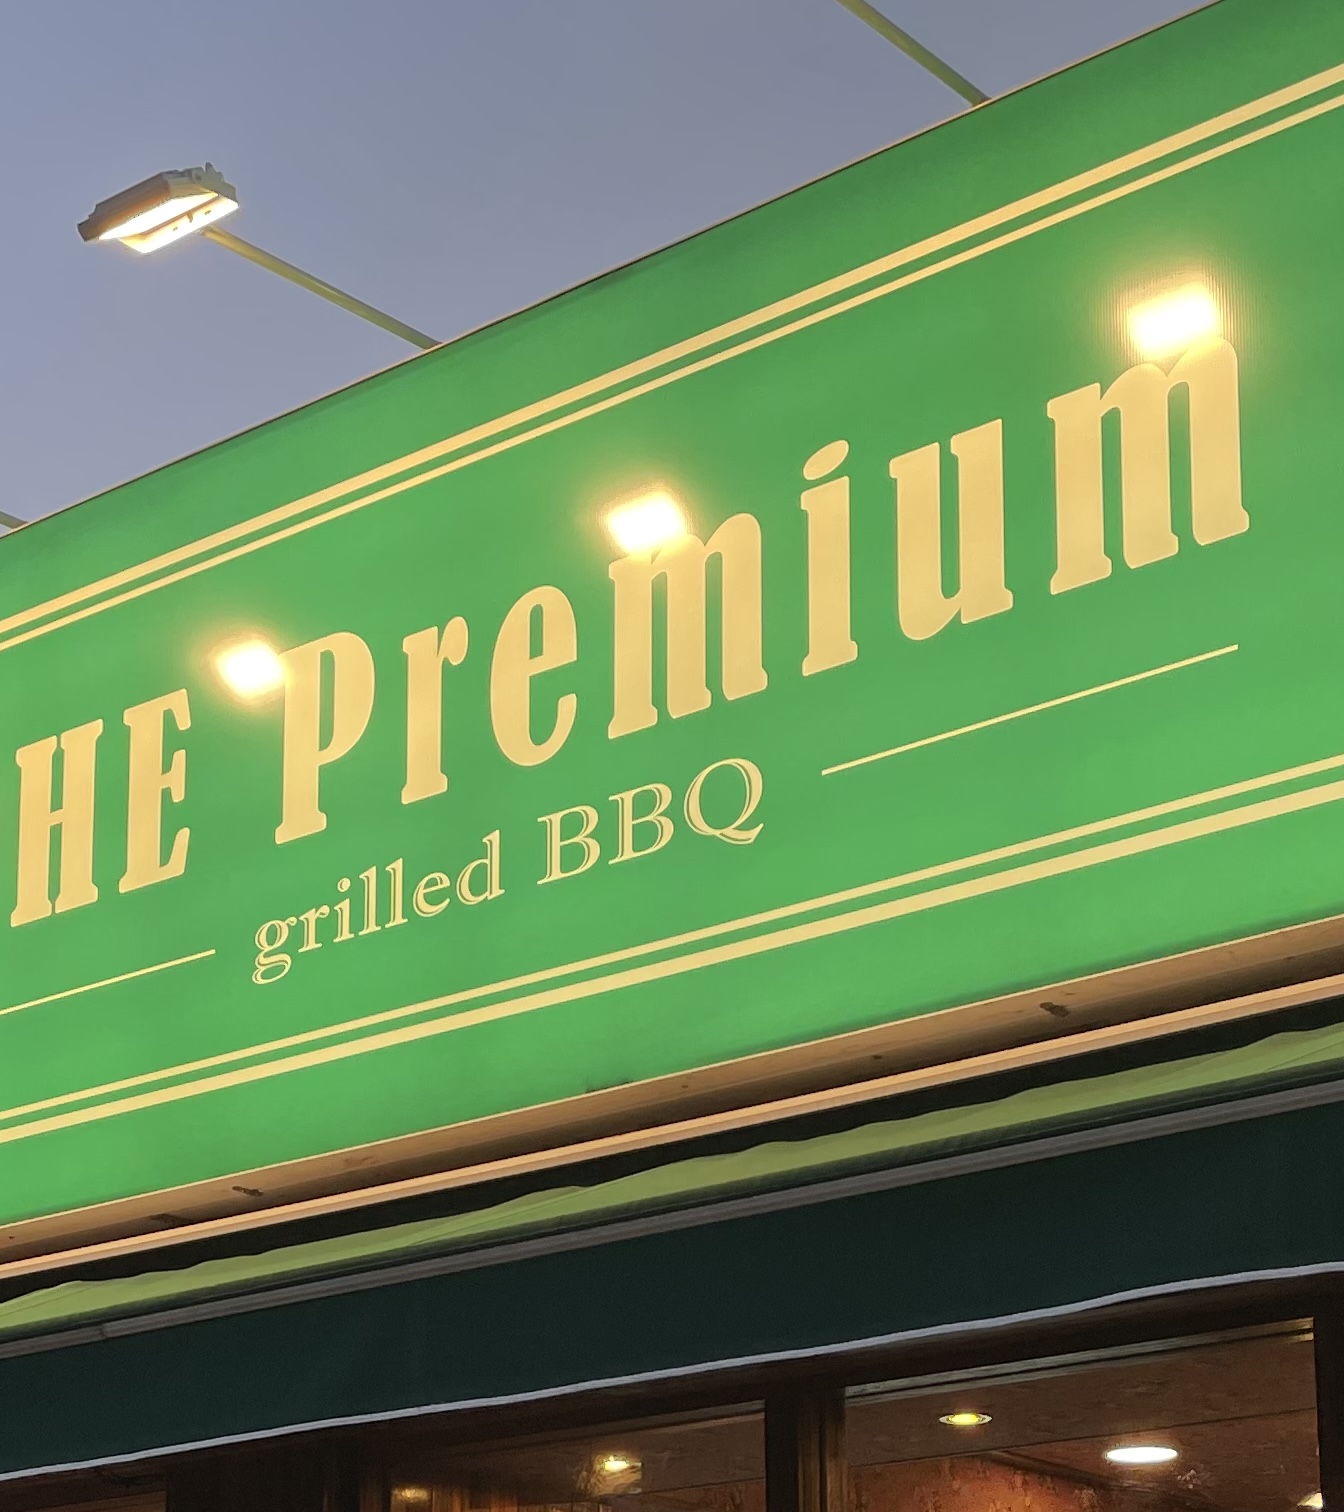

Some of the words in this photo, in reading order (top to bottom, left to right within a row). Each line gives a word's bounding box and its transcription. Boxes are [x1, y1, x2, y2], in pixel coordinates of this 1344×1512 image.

[275, 335, 1251, 845] Premium
[250, 829, 504, 985] grilled
[537, 756, 766, 889] BBQ
